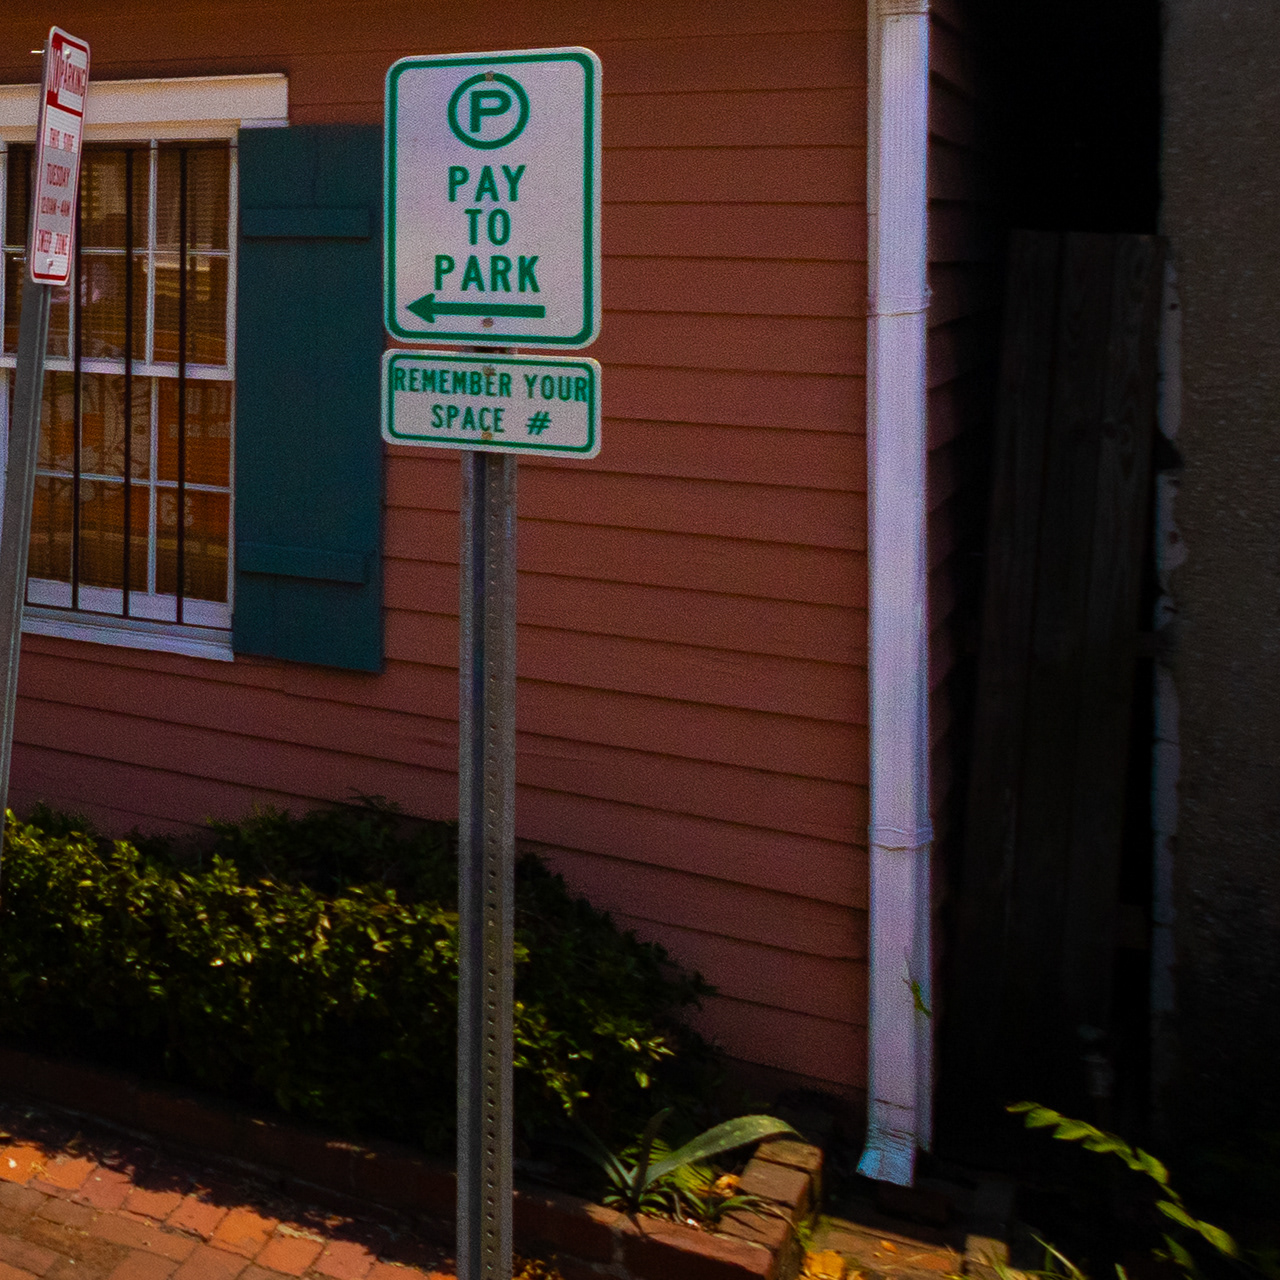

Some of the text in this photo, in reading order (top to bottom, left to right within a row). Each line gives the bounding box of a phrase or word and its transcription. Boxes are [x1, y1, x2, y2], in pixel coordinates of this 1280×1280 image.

[447, 164, 526, 203] PAY
[464, 208, 511, 246] TO
[434, 254, 541, 293] PARK
[394, 366, 588, 402] REMEMBER YOUR
[431, 403, 505, 433] SPACE
